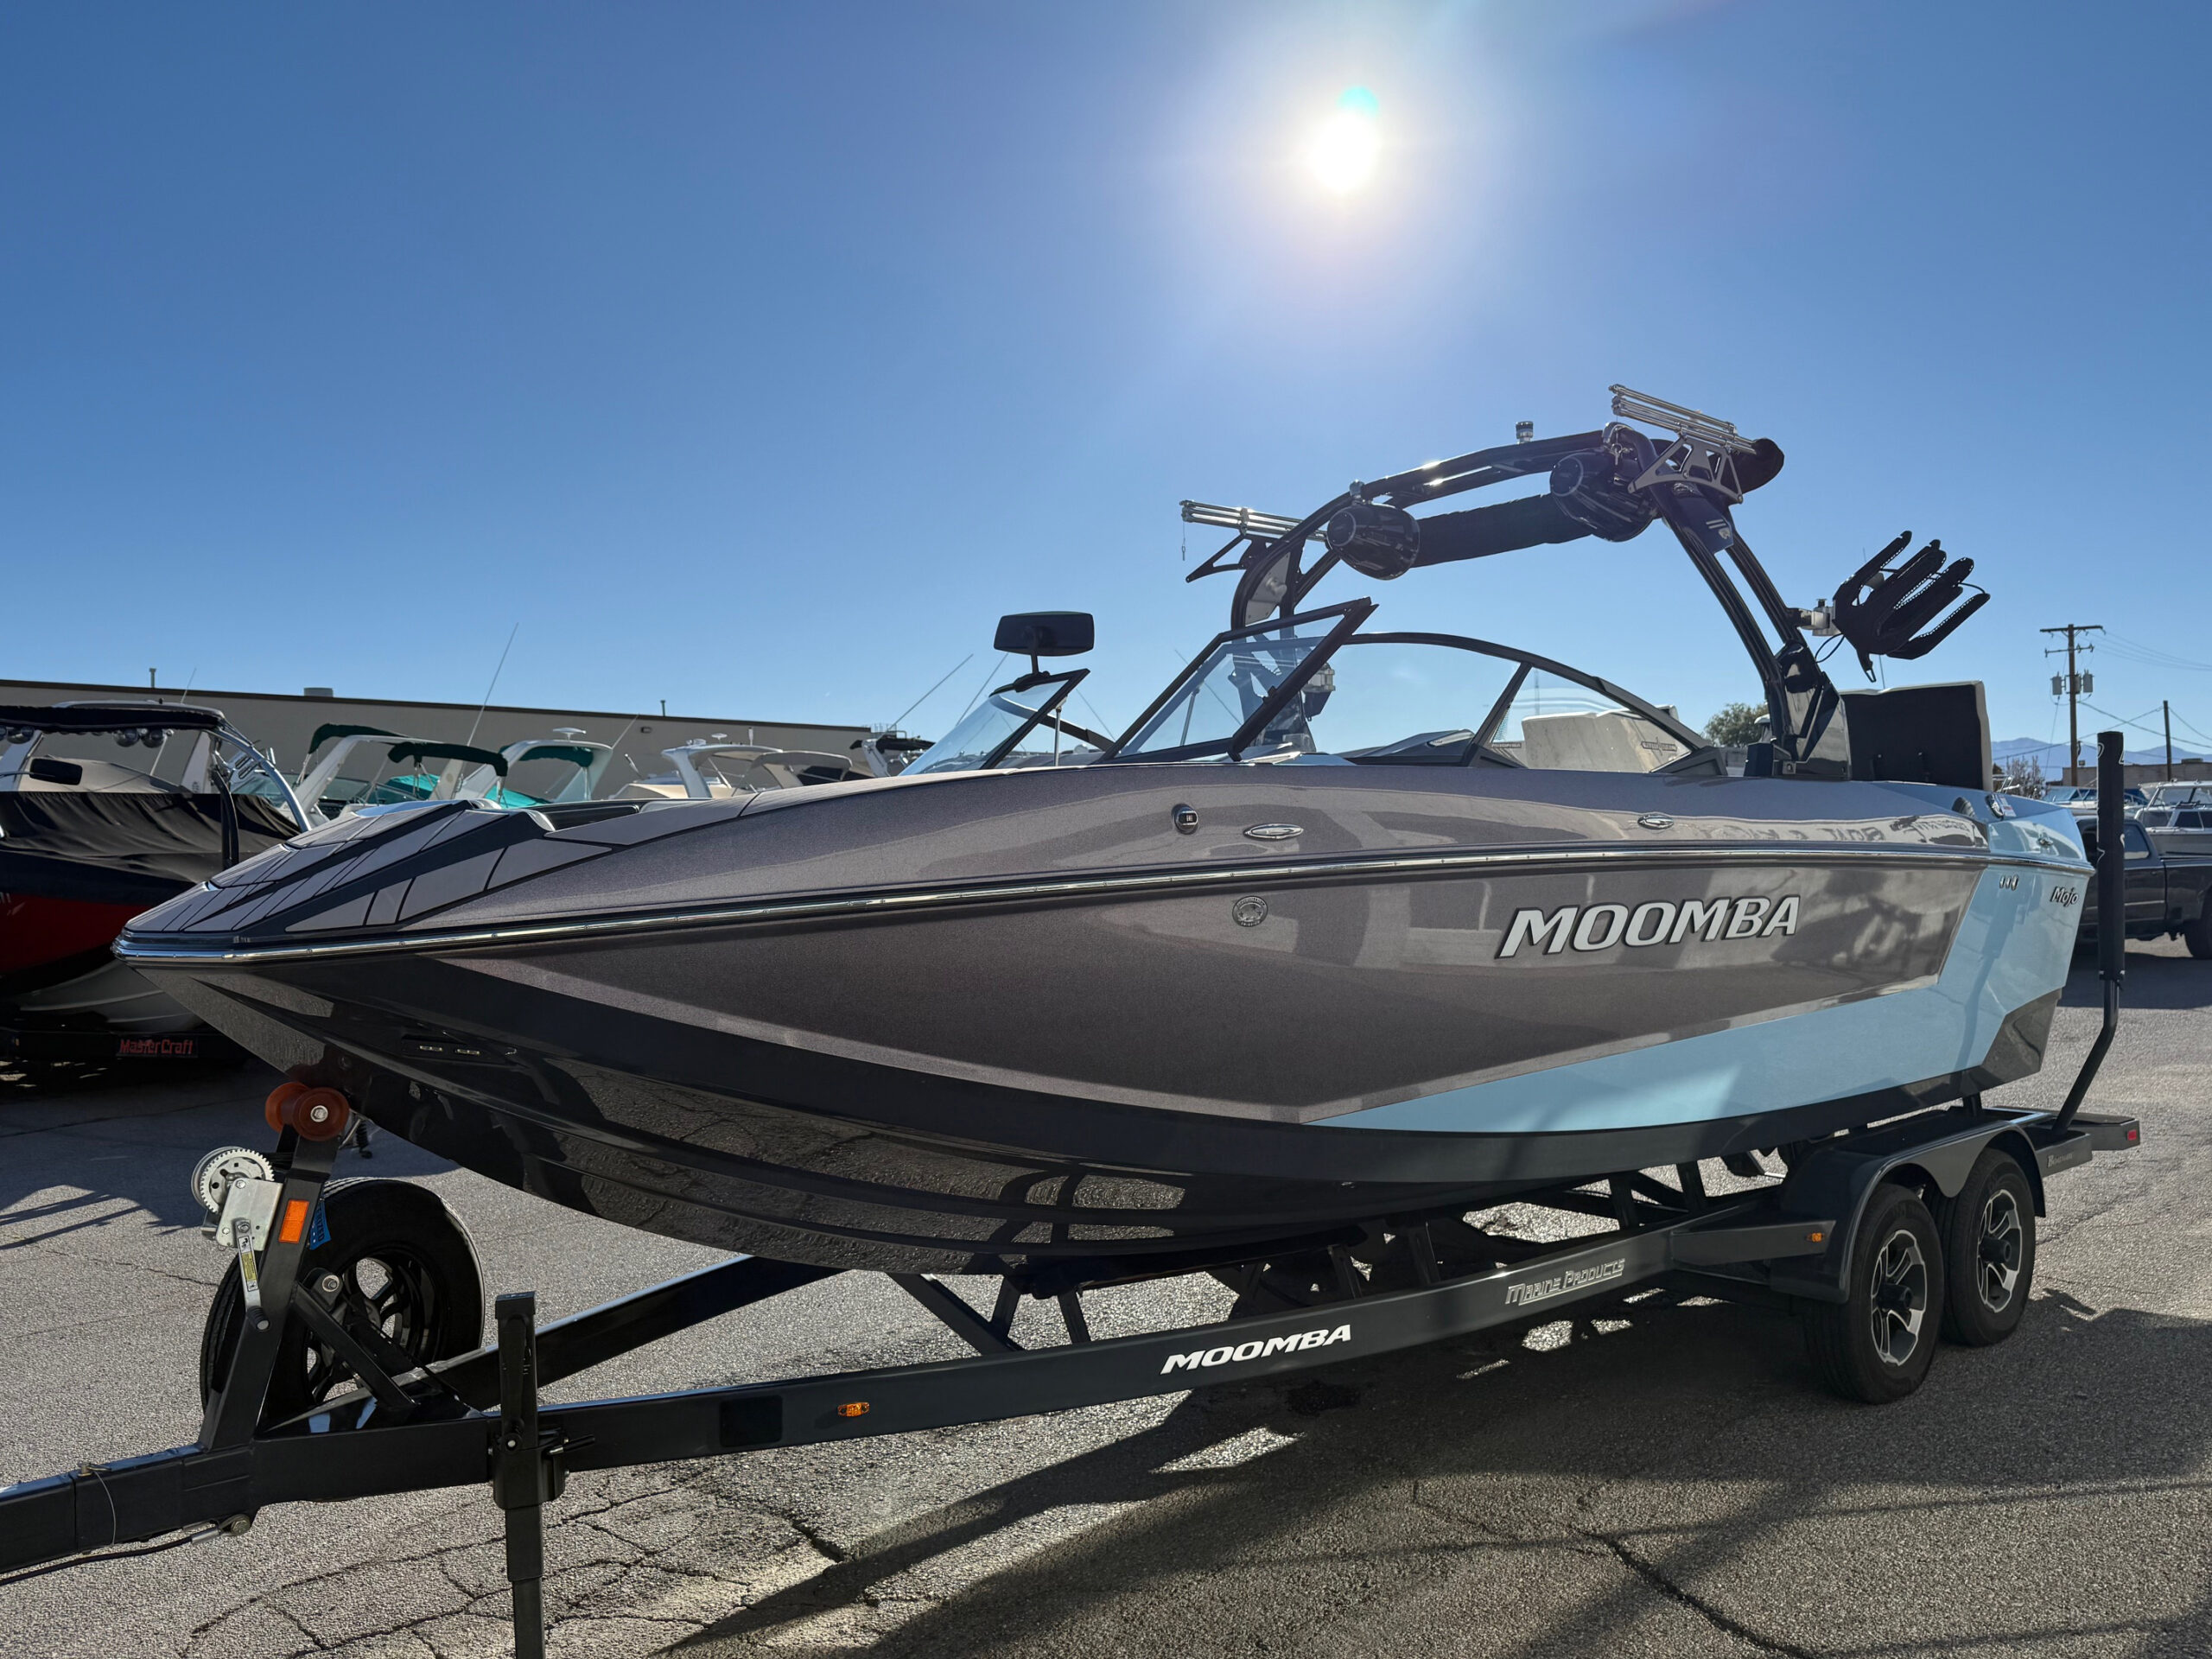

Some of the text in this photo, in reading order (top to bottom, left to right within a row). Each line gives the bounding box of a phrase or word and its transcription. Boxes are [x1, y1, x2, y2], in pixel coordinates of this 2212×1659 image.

[2050, 886, 2079, 907] Mojo
[1494, 894, 1801, 960] MOOMBA
[1160, 1324, 1352, 1375] MOOMBA
